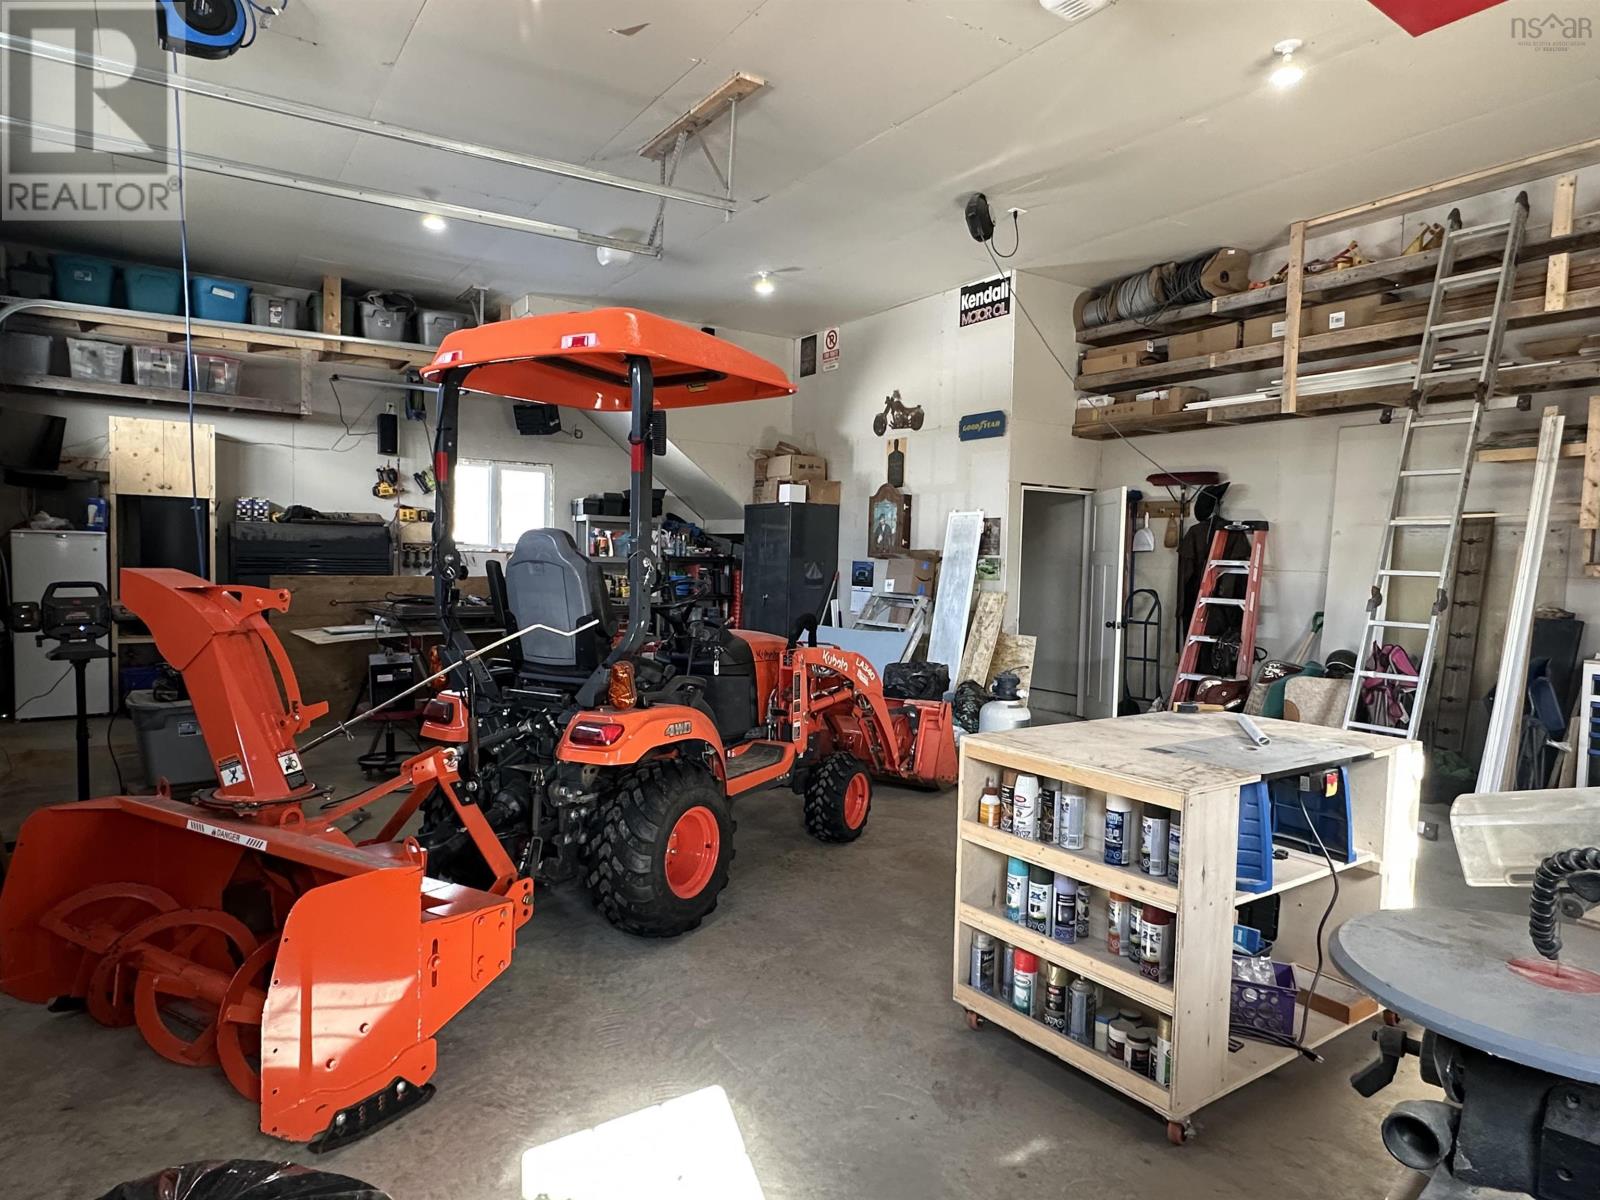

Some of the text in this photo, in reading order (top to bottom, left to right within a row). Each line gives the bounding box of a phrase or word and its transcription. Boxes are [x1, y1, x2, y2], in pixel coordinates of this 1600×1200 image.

[961, 281, 1009, 311] Kendall
[961, 306, 992, 326] MOTOR
[963, 419, 1001, 432] GOODYEAR
[822, 649, 848, 672] Kubota
[664, 720, 692, 737] 4WD
[216, 829, 240, 841] DANGER
